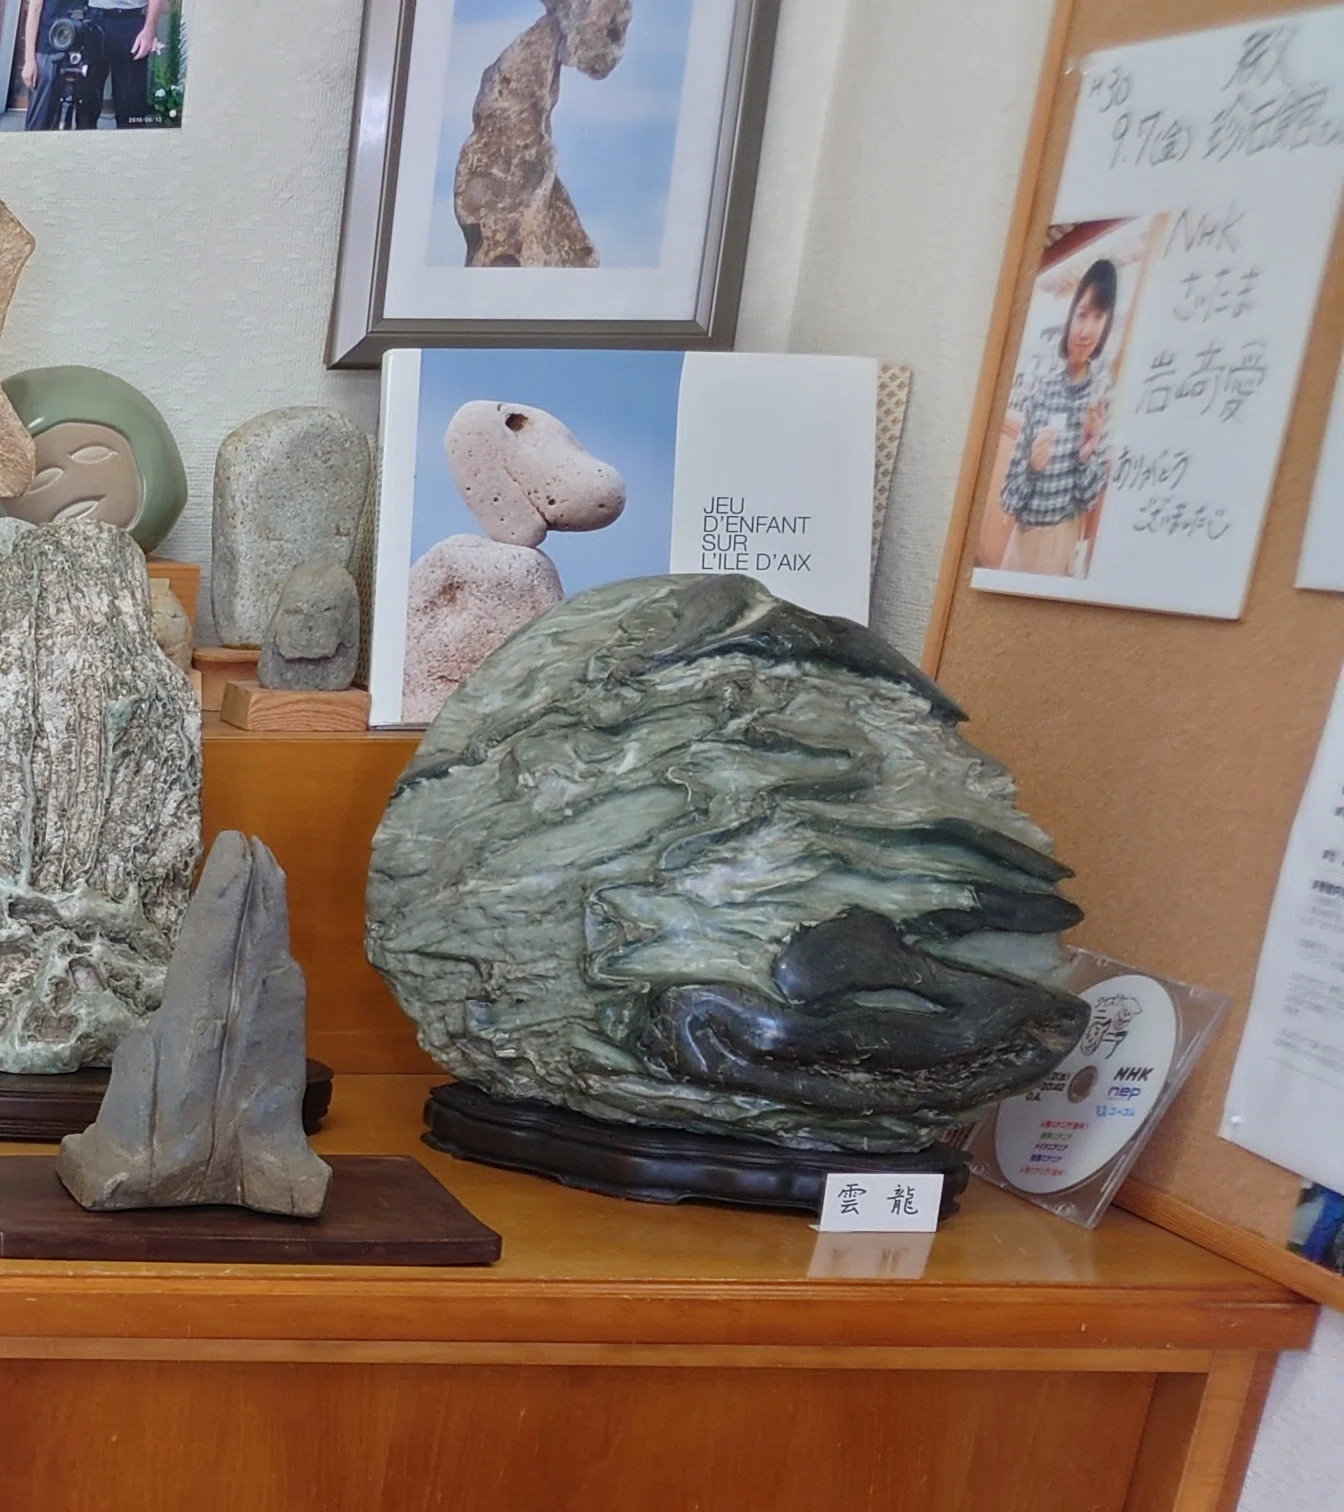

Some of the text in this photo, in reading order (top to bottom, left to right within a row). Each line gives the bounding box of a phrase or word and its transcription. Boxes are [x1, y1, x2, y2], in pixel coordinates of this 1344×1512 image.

[1163, 200, 1245, 260] NHK
[703, 496, 745, 515] JEU
[703, 515, 812, 534] D'ENFANT
[701, 533, 748, 552] SUR
[701, 552, 812, 572] L'ILE D'AIX
[1113, 1066, 1154, 1082] NHK
[1108, 1086, 1141, 1101] nep
[837, 1183, 919, 1215] 雲龍
